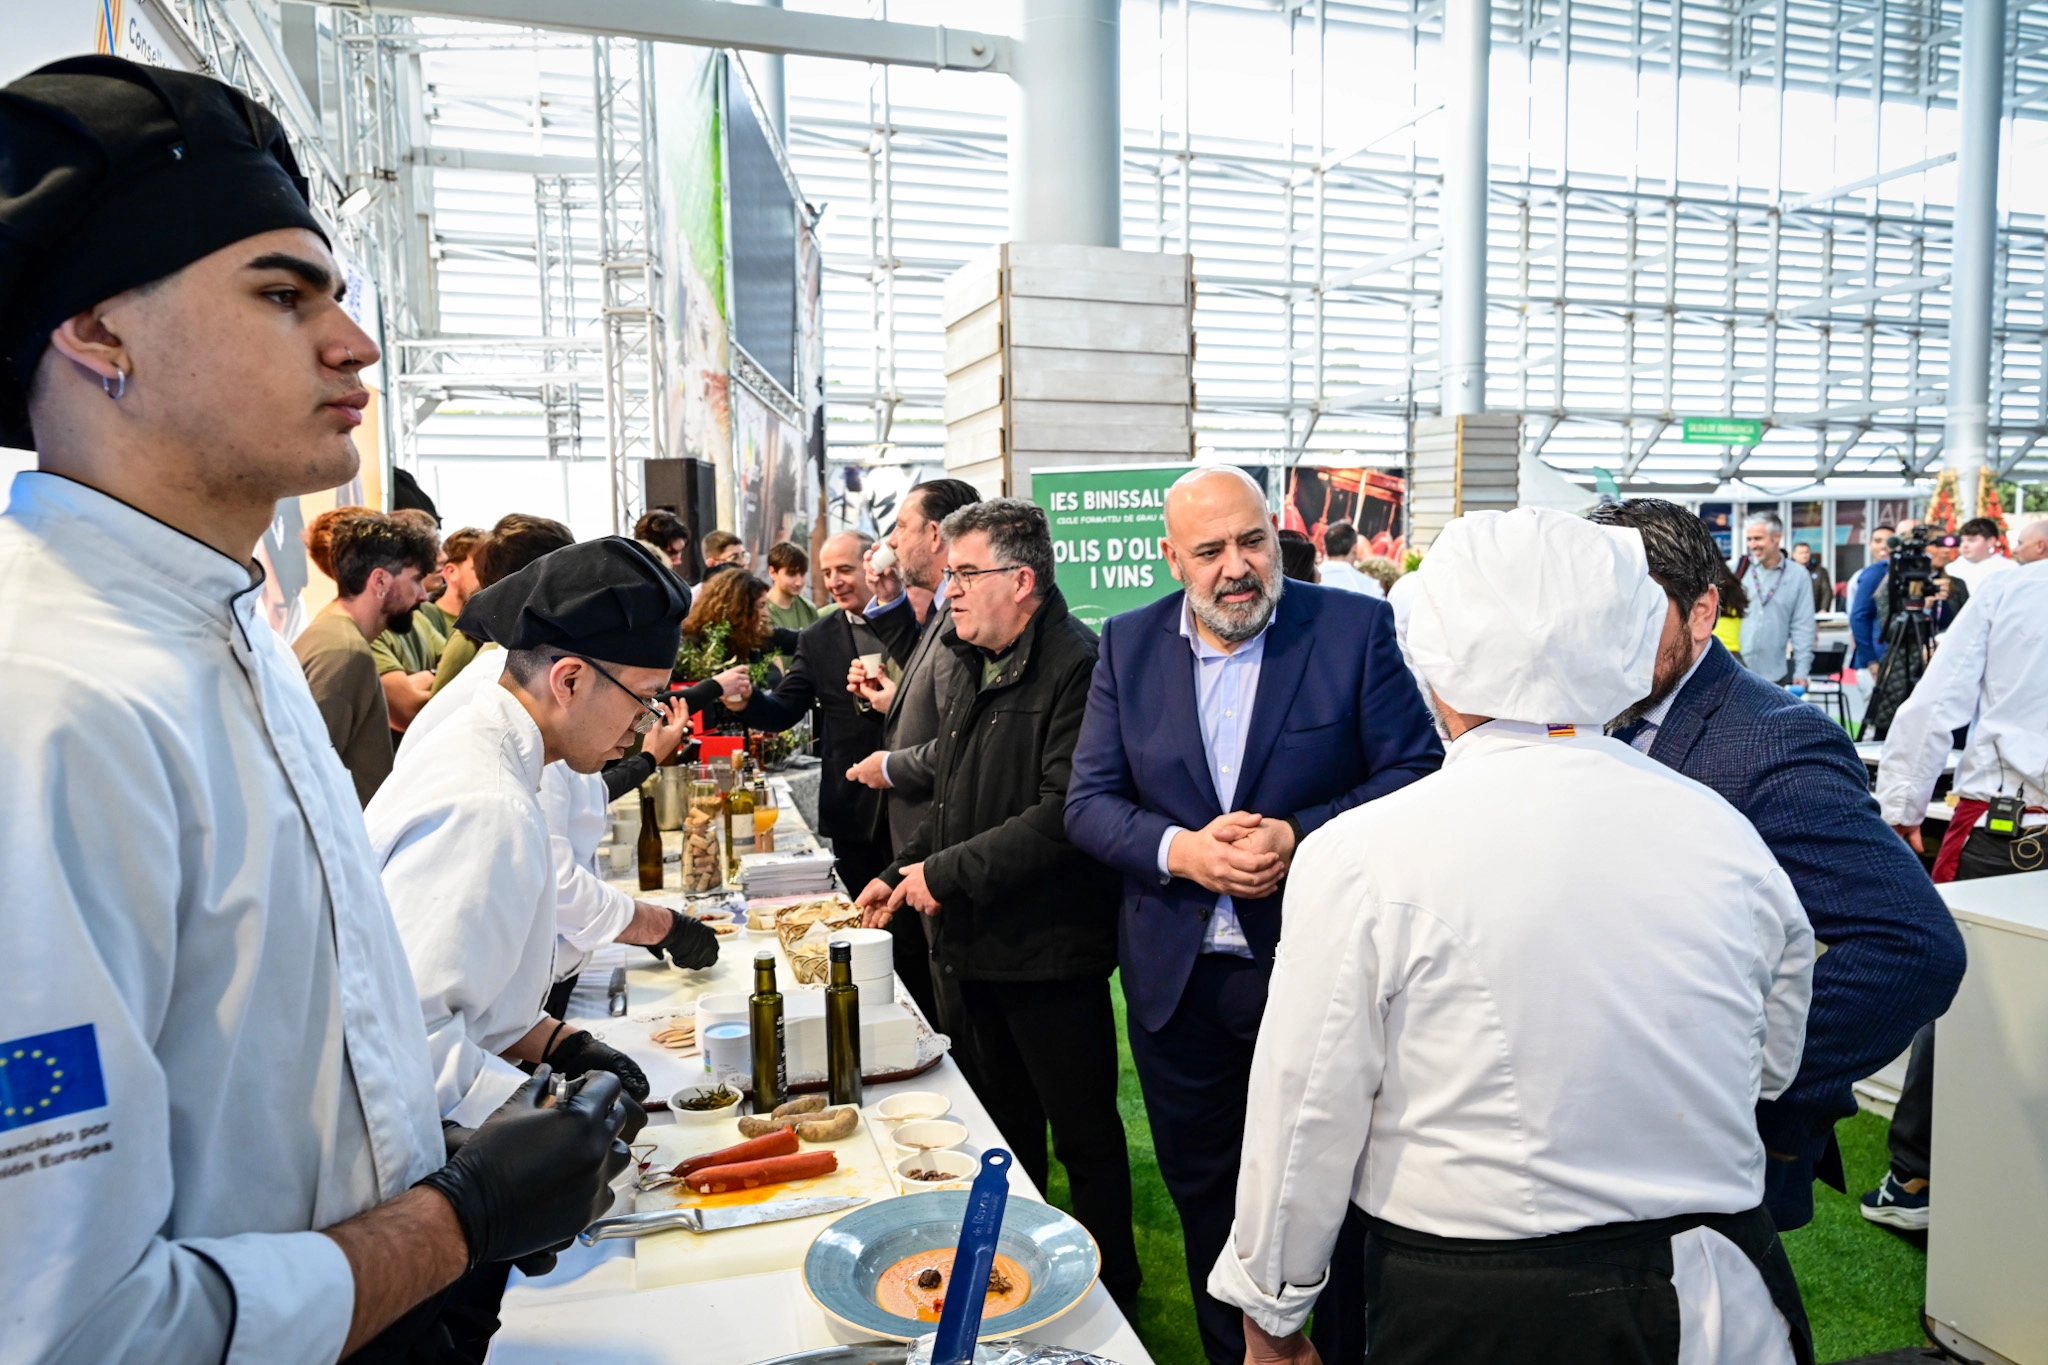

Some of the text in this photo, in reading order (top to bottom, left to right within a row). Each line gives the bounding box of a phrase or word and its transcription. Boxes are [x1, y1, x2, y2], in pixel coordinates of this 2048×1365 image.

[1050, 492, 1079, 512] IES
[1056, 516, 1078, 525] CICLE
[1080, 515, 1122, 524] FORMATIU
[1123, 514, 1134, 523] DE
[1136, 514, 1157, 522] GRAU
[1091, 564, 1154, 589] I VINS
[79, 1122, 110, 1141] por
[39, 1141, 113, 1169] Europea
